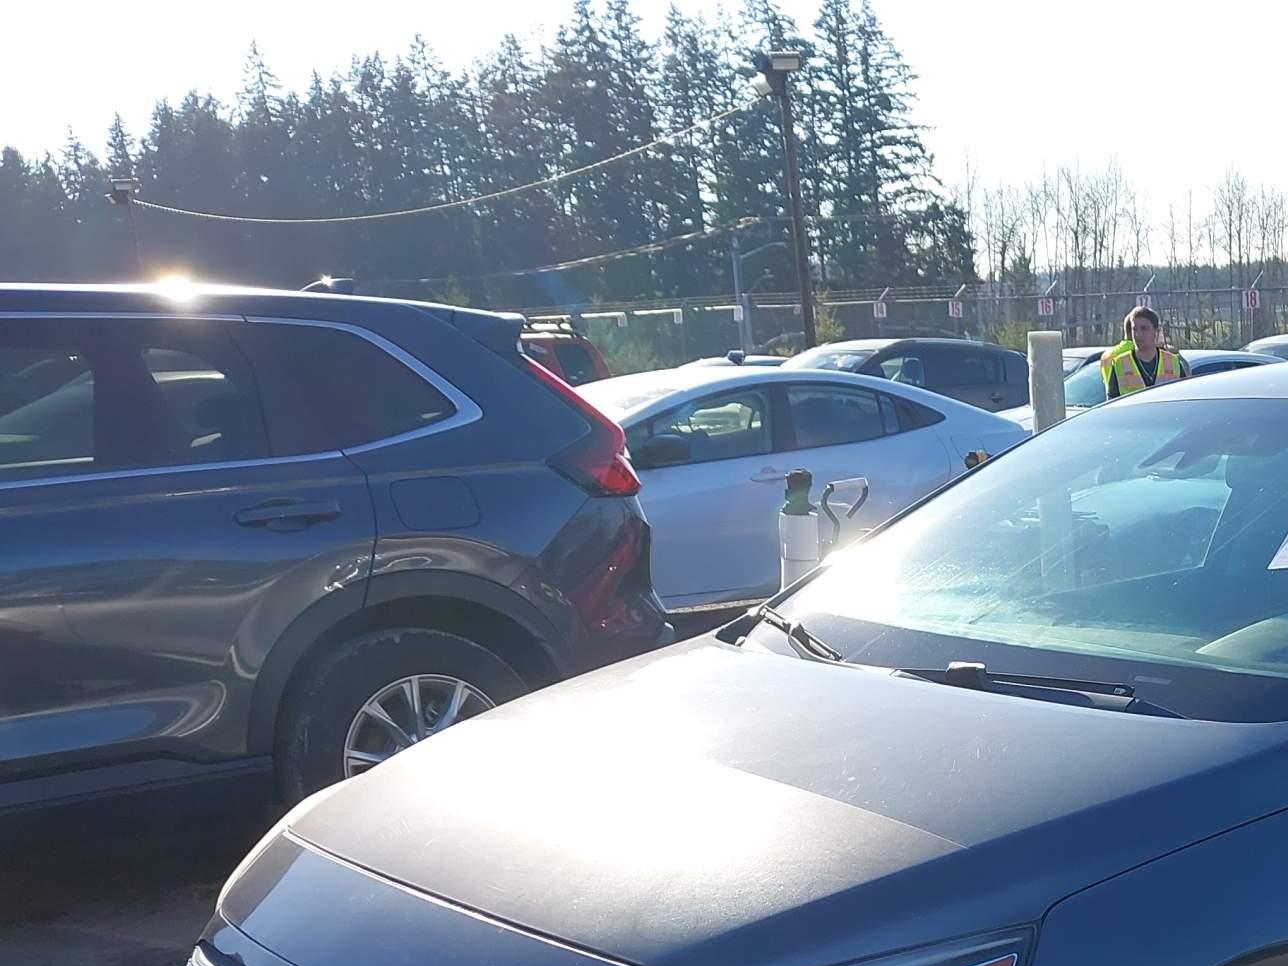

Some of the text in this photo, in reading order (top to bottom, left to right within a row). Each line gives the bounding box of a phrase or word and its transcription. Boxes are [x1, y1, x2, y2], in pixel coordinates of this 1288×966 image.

[1244, 289, 1257, 308] 18
[950, 301, 962, 316] 15
[1040, 299, 1053, 314] 16
